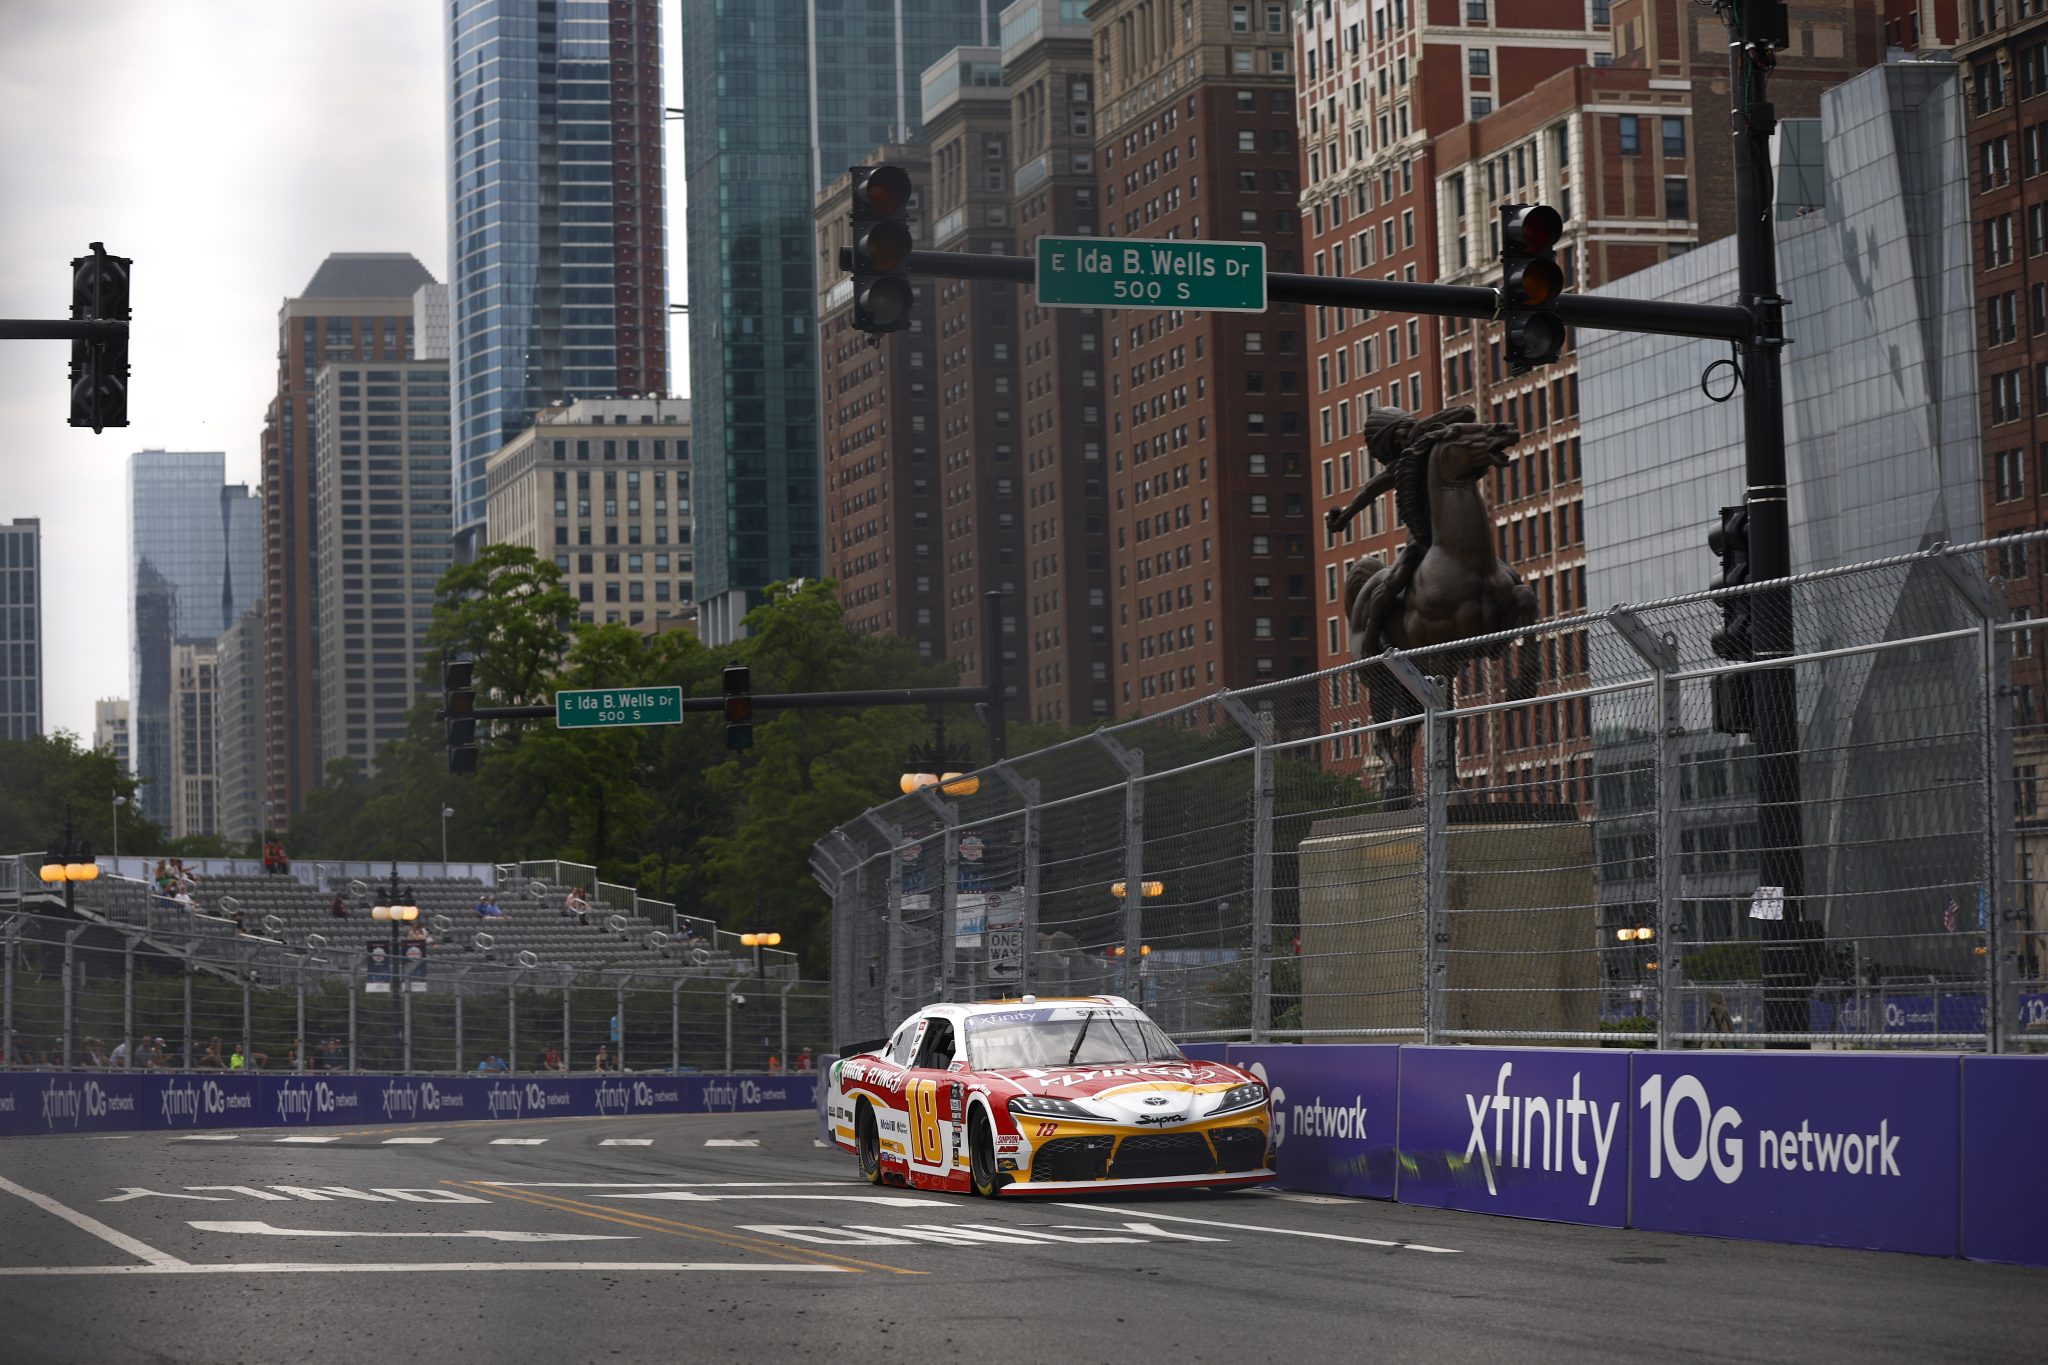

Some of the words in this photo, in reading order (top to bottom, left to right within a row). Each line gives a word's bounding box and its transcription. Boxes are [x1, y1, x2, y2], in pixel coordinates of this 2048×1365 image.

[1052, 253, 1065, 271] E
[1077, 248, 1113, 273] Ida
[1152, 250, 1215, 277] Wells
[1225, 259, 1250, 278] Dr
[1114, 280, 1161, 298] 500
[1177, 282, 1191, 300] S
[565, 700, 573, 710] E
[578, 696, 598, 709] Ida
[619, 693, 655, 707] Wells
[660, 696, 673, 706] Dr
[599, 711, 625, 721] 500
[633, 710, 641, 720] S
[990, 948, 1019, 959] WAY
[991, 933, 1019, 947] ONE
[980, 1010, 1037, 1025] xfinity
[41, 1077, 82, 1128] xfinity
[84, 1080, 107, 1117] 10G
[108, 1092, 134, 1111] network
[161, 1077, 201, 1125] xfinity
[203, 1080, 225, 1114] 10G
[226, 1092, 252, 1109] network
[276, 1079, 313, 1122] xfinity
[315, 1081, 335, 1112] 10G
[335, 1092, 359, 1107] network
[382, 1079, 418, 1119] xfinity
[420, 1081, 440, 1111] 10G
[441, 1092, 464, 1107] network
[487, 1081, 524, 1119] xfinity
[525, 1082, 546, 1110] 10G
[546, 1091, 571, 1105] network
[594, 1079, 630, 1117] xfinity
[633, 1081, 654, 1107] 10G
[654, 1089, 680, 1102] network
[702, 1079, 738, 1113] xfinity
[740, 1079, 762, 1104] 10G
[762, 1087, 787, 1100] network
[905, 1077, 943, 1165] 18
[1036, 1122, 1059, 1137] 18
[1135, 1114, 1188, 1129] Supra
[1293, 1094, 1368, 1140] network
[997, 1135, 1019, 1144] SIMPSON
[1463, 1061, 1621, 1207] xfinity
[1640, 1074, 1743, 1184] 10G
[1759, 1118, 1901, 1177] network
